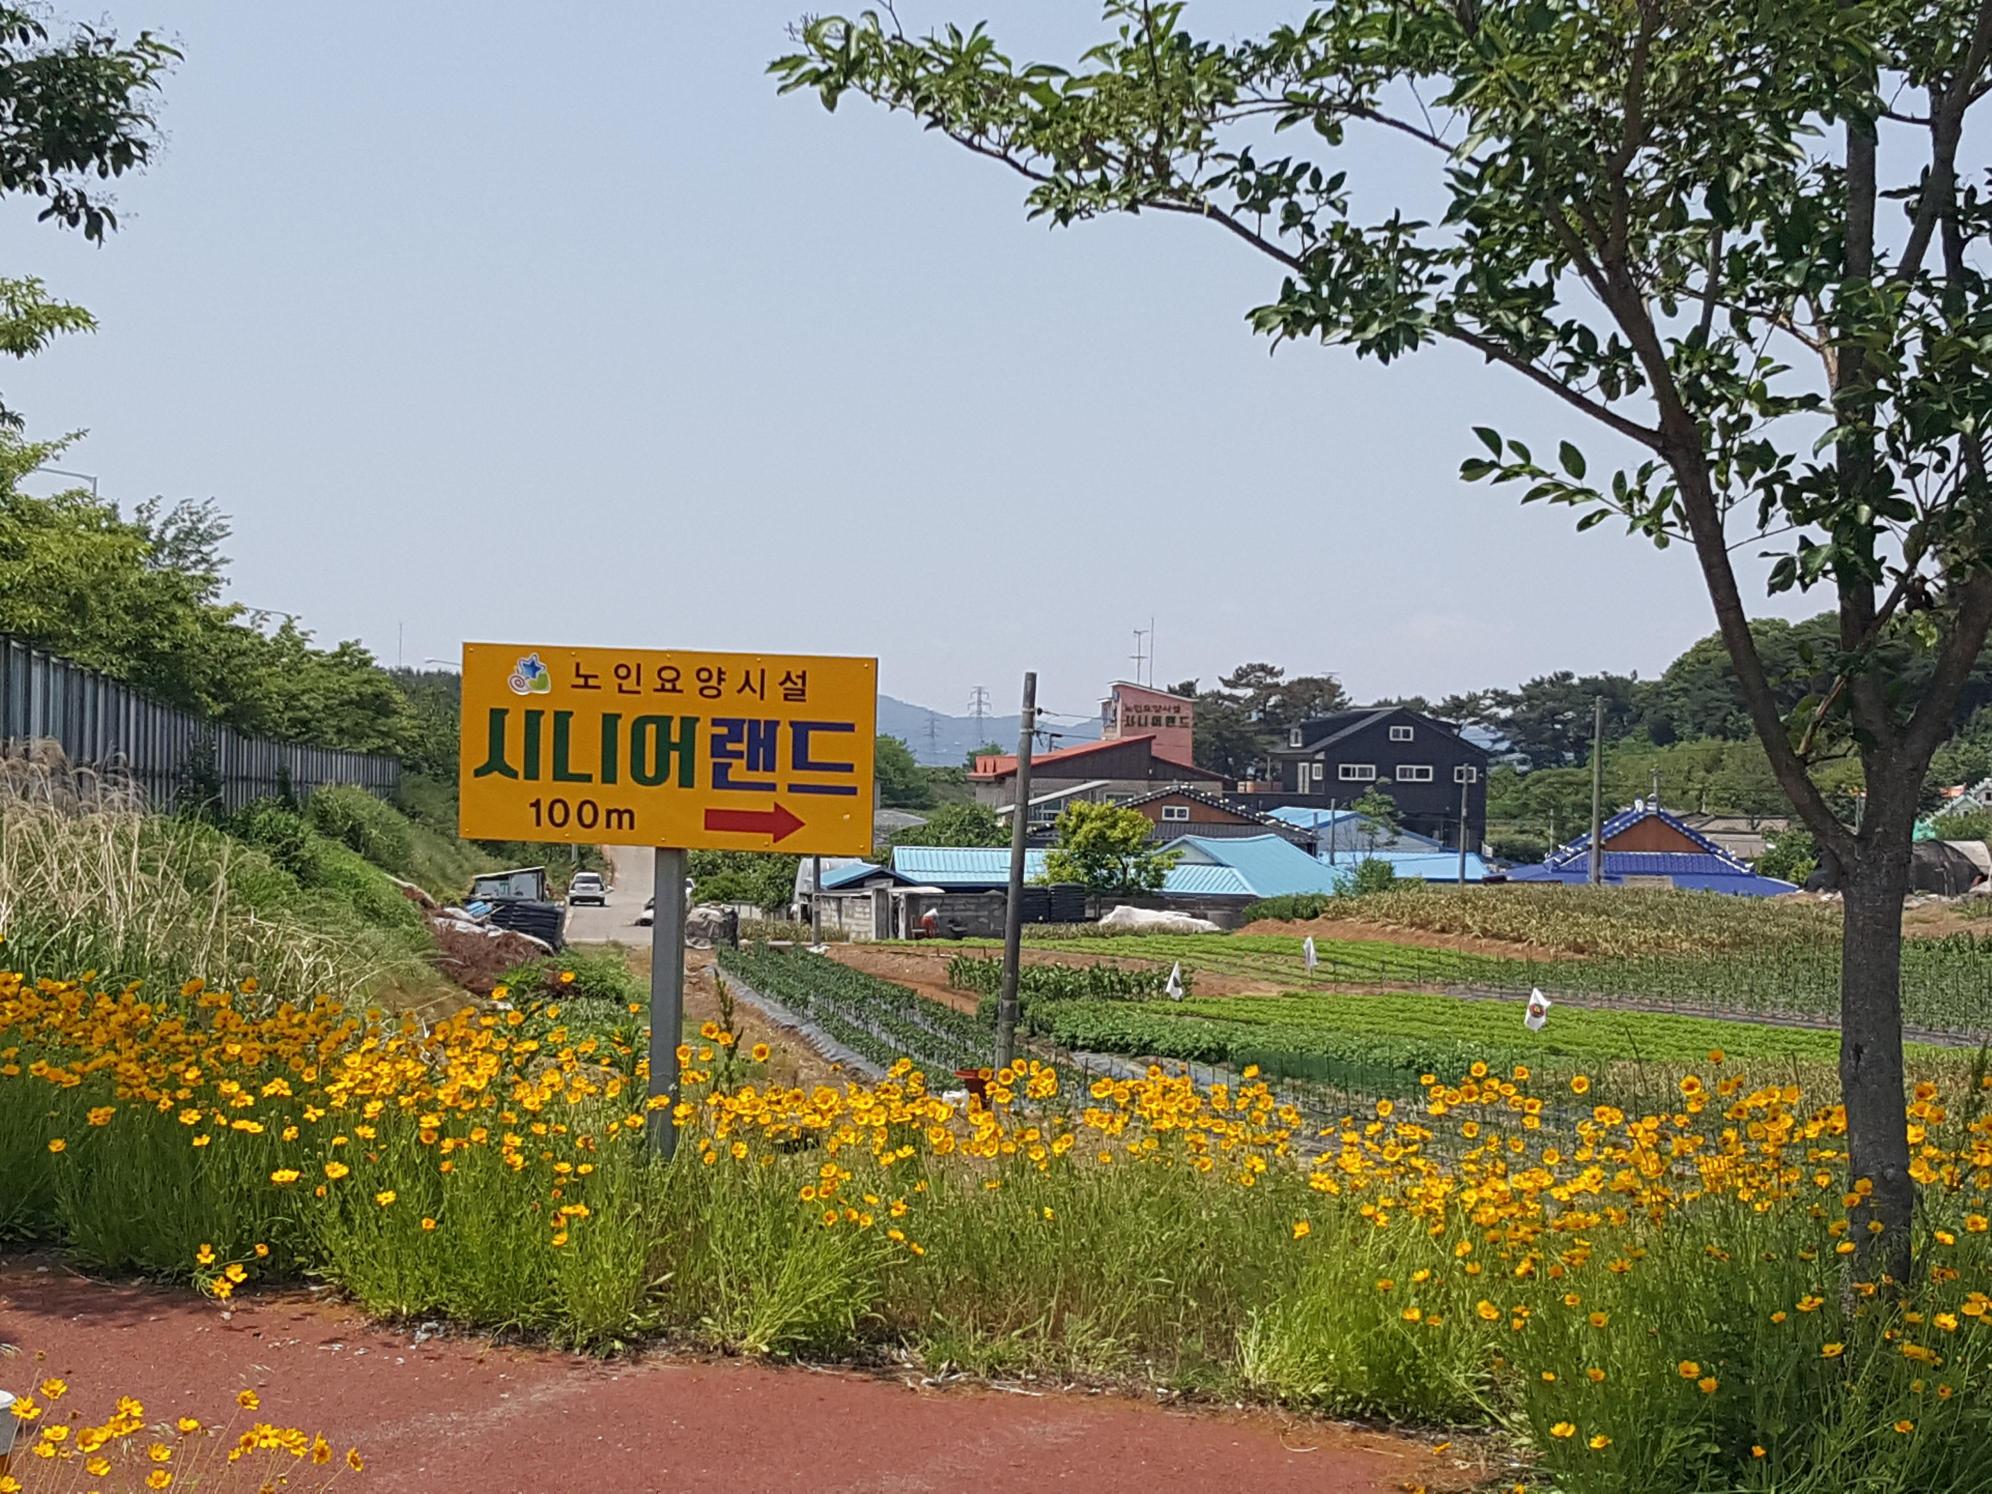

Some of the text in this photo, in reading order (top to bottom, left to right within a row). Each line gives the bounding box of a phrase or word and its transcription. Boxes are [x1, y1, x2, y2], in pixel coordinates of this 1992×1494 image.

[570, 661, 808, 703] 노인요양시설
[473, 707, 858, 796] 시니어랜드
[529, 798, 636, 831] 100m
